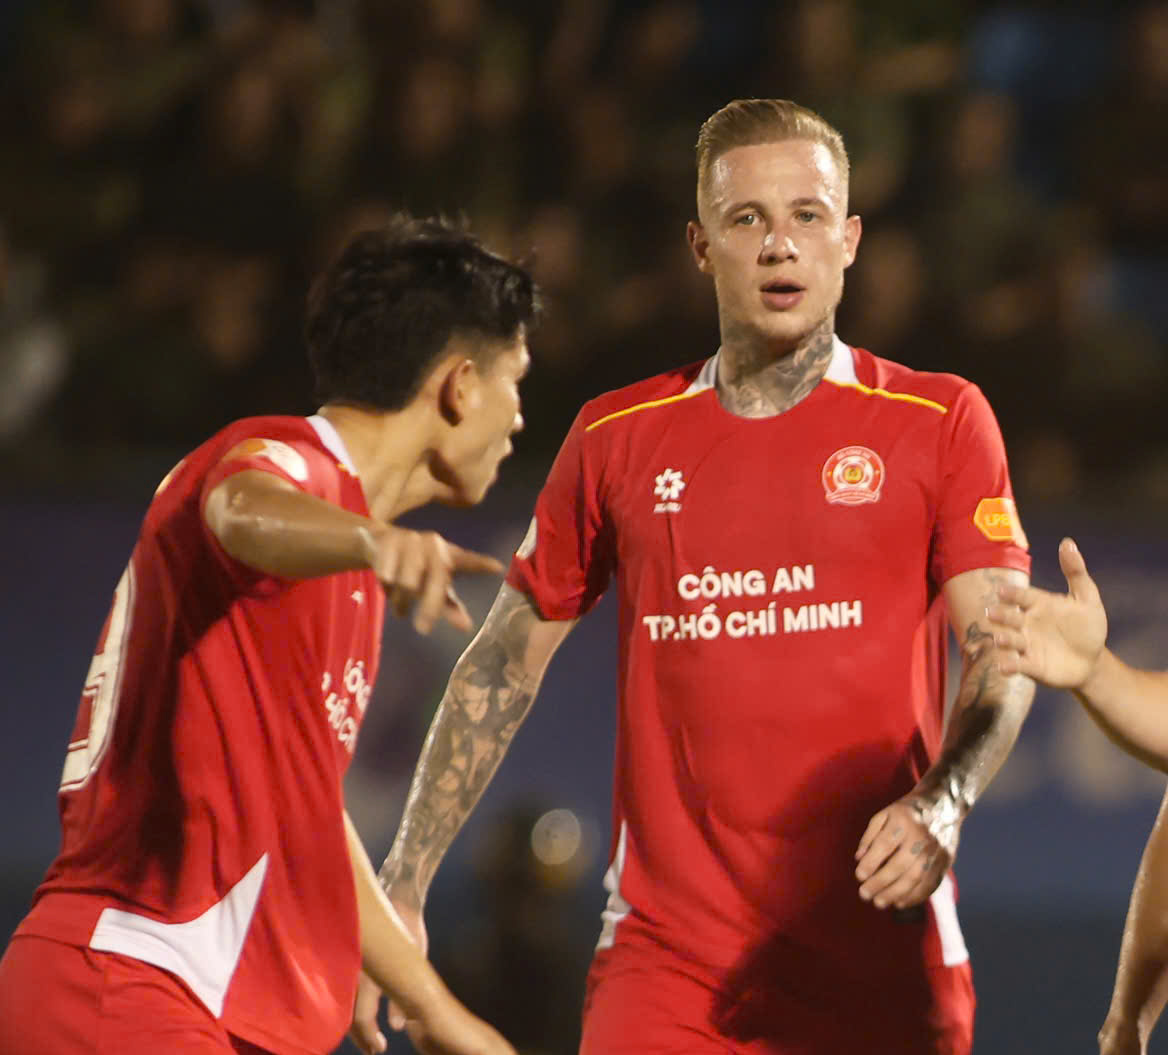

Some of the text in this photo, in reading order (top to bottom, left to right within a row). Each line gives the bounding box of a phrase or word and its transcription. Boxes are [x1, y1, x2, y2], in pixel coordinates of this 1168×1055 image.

[678, 564, 815, 600] CÔNG AN
[726, 601, 777, 638] CHÍ
[783, 600, 862, 633] MINH
[58, 559, 137, 793] 9
